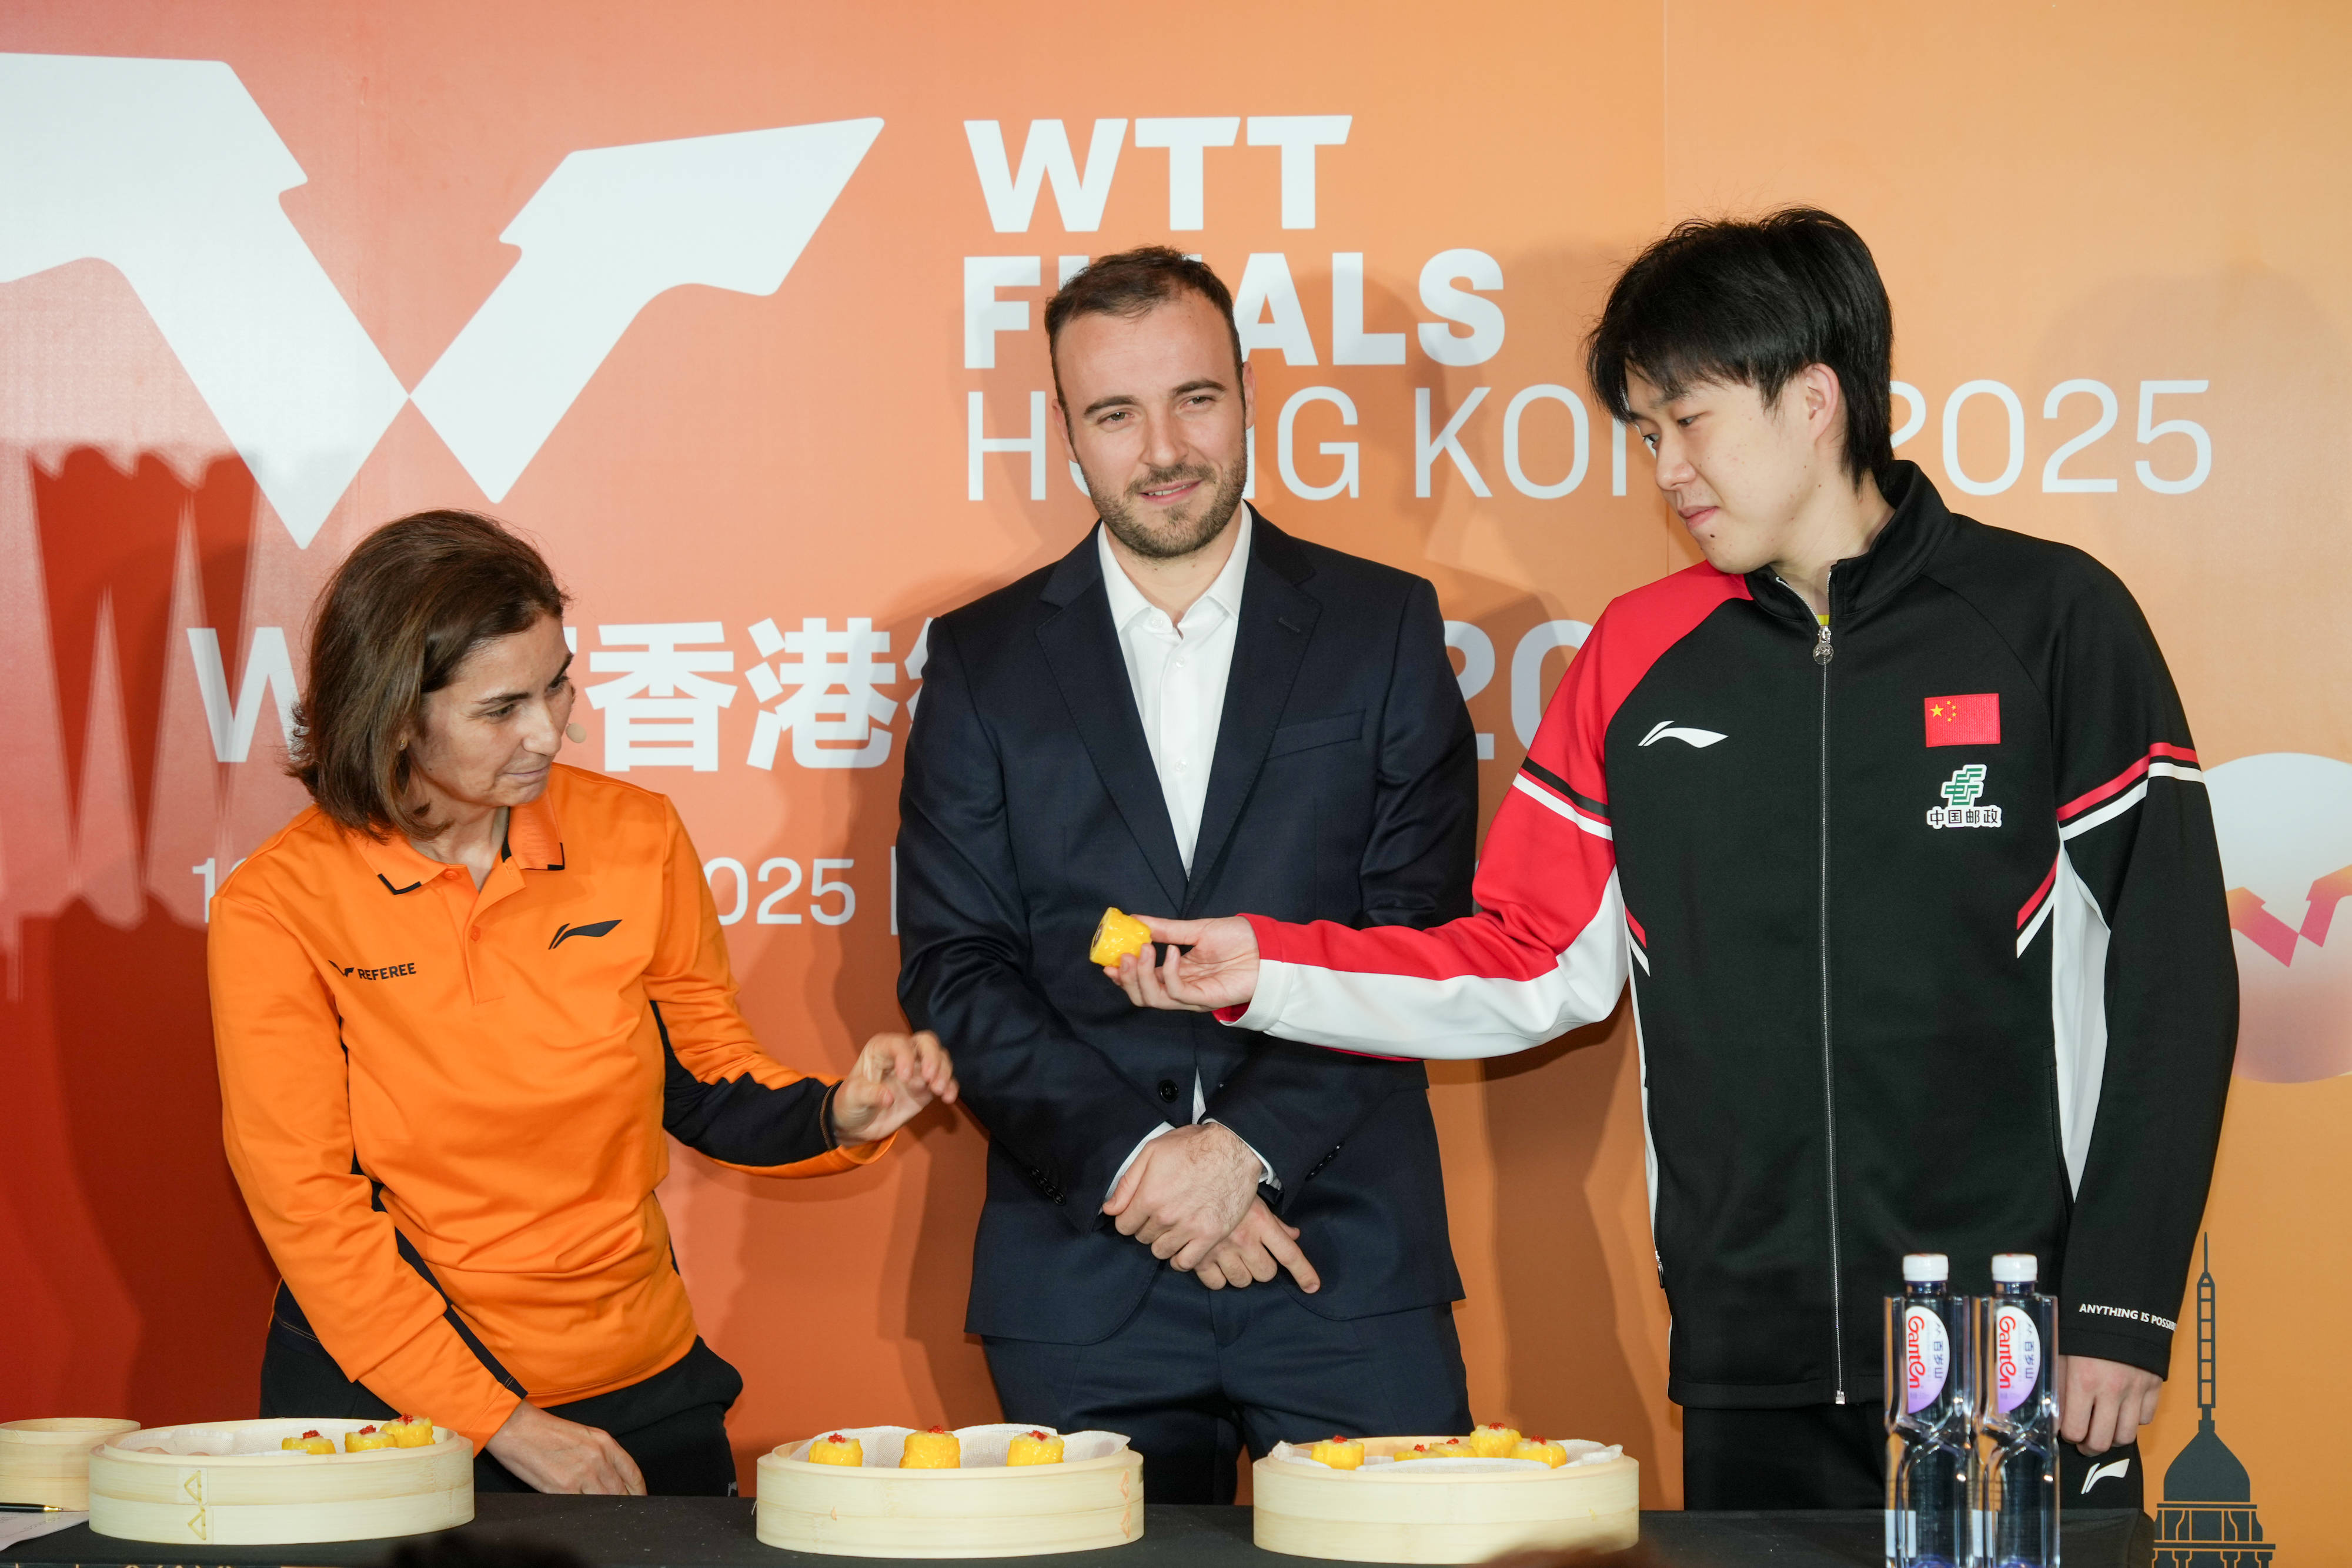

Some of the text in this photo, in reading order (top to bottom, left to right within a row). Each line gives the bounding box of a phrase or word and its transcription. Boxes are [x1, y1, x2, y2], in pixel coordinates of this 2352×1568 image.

[963, 115, 1353, 233] WTT
[963, 248, 1505, 369] FALS
[967, 386, 1359, 502] HG
[1930, 808, 1999, 825] 中国邮政
[703, 857, 856, 926] 025
[357, 962, 417, 981] REFEREE
[2079, 1303, 2177, 1332] ANYTHING IS POSSIB
